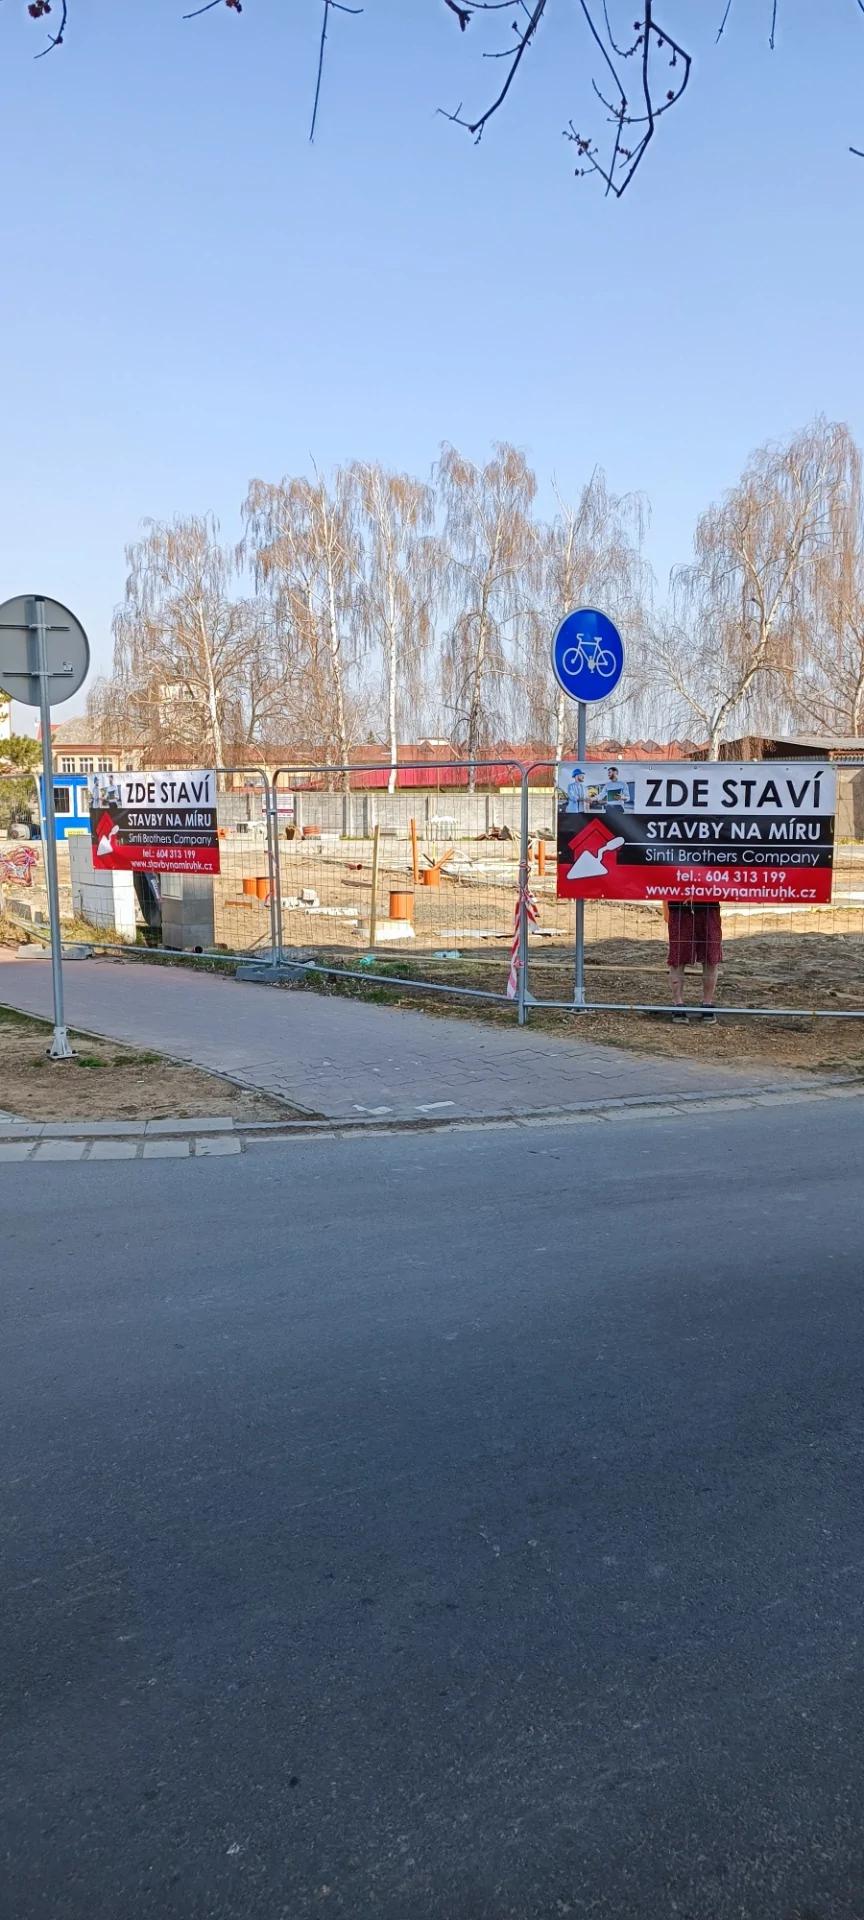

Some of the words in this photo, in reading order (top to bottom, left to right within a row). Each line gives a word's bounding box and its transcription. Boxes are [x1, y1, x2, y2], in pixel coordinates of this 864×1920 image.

[126, 783, 155, 803] ZDE
[161, 774, 210, 802] STAVÍ
[645, 779, 708, 807] ZDE
[721, 771, 824, 808] STAVÍ
[128, 814, 163, 826] STAVBY
[166, 814, 181, 826] NA
[185, 810, 211, 826] MÍRU
[647, 822, 723, 839] STAVBY
[731, 823, 761, 839] NA
[769, 818, 820, 840] MÍRU
[129, 834, 141, 843] Sinti
[143, 835, 171, 843] Brothers
[174, 835, 211, 846] Company
[143, 850, 154, 858] tel.:
[156, 850, 168, 858] 604
[169, 850, 181, 858] 313
[184, 850, 195, 858] 199
[645, 849, 673, 862] Sinti
[679, 850, 736, 863] Brothers
[742, 851, 819, 866] Company
[677, 871, 700, 881] tel.:
[706, 872, 728, 882] 604
[733, 872, 757, 882] 313
[763, 872, 786, 882] 199
[647, 885, 816, 898] www.stavbynamiruhk.cz
